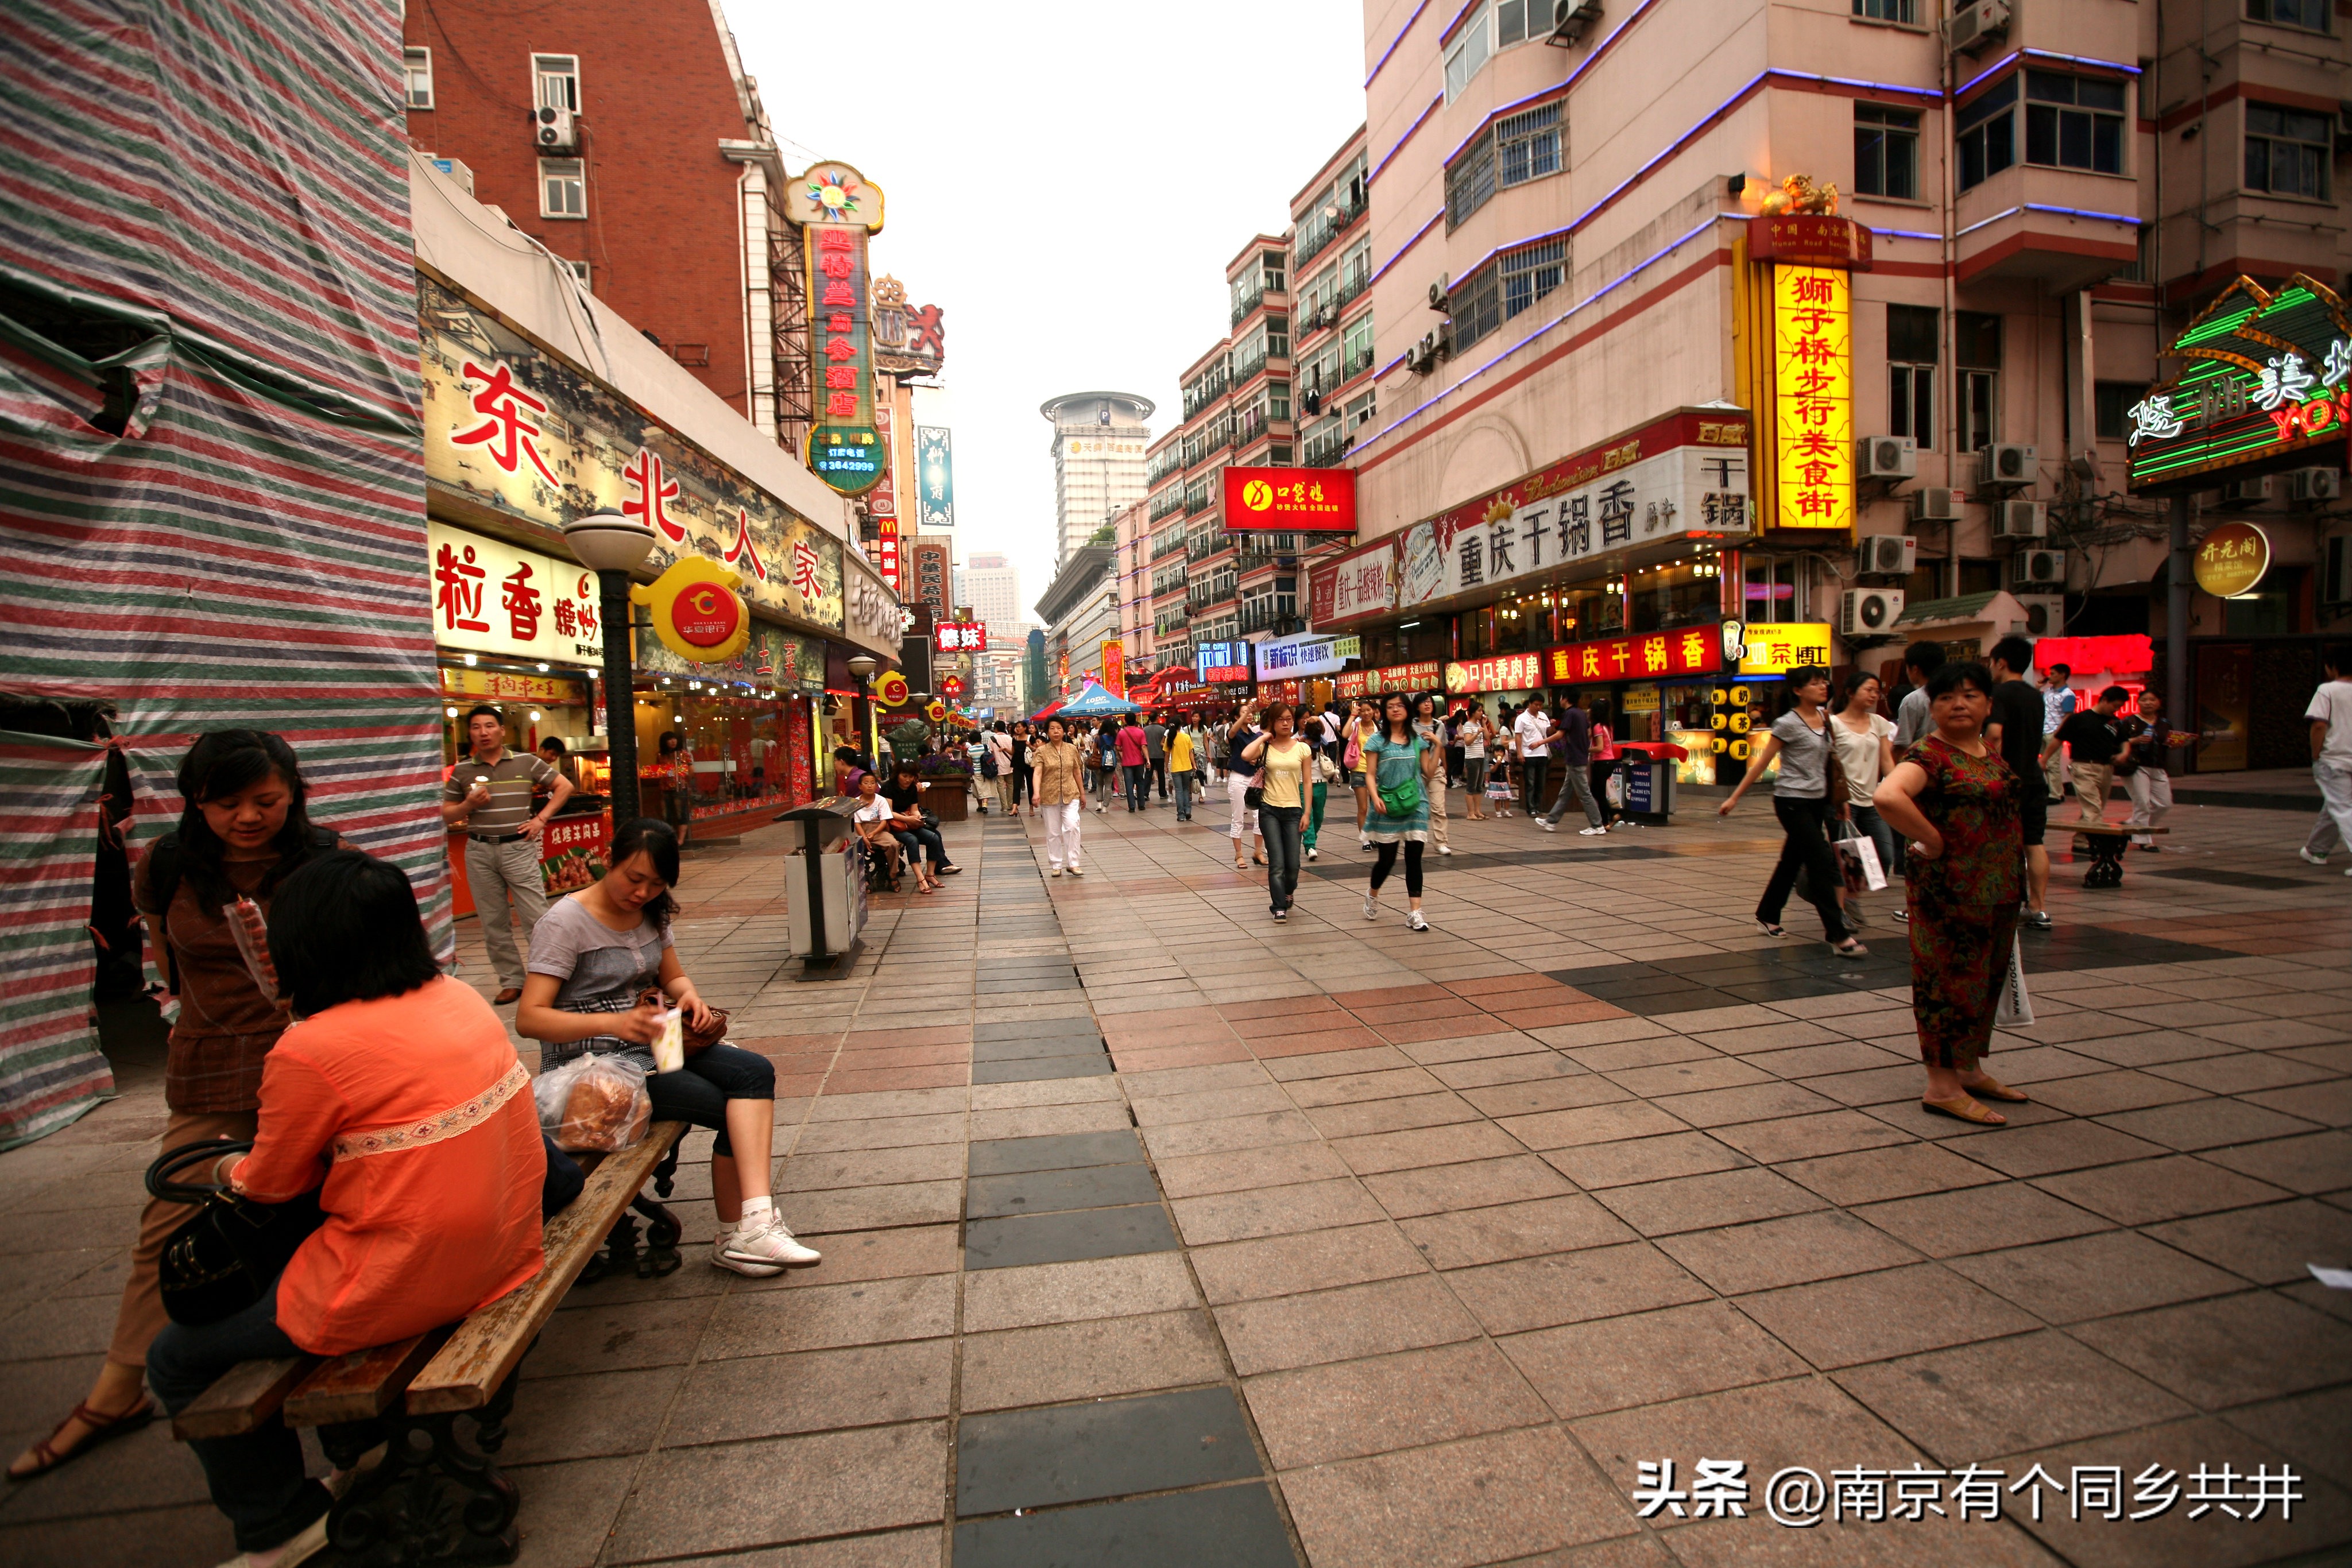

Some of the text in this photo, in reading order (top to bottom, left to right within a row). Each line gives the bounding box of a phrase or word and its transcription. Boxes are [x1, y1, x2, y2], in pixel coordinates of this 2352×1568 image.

[818, 229, 860, 417] 亚特兰商务酒店
[1102, 411, 1108, 420] P
[1790, 274, 1839, 518] 狮子桥步行美食街
[451, 361, 823, 599] 东北人家
[1277, 481, 1324, 503] 口袋鸡
[1701, 457, 1746, 525] 干锅
[1459, 479, 1635, 587] 重庆干锅香
[881, 541, 897, 586] 麦当劳
[683, 625, 725, 633] 华夏银行
[1270, 644, 1298, 670] 新标识
[1469, 654, 1539, 682] 口口香肉串
[1552, 632, 1705, 680] 重庆干锅香
[1738, 690, 1748, 756] 奶茶屋
